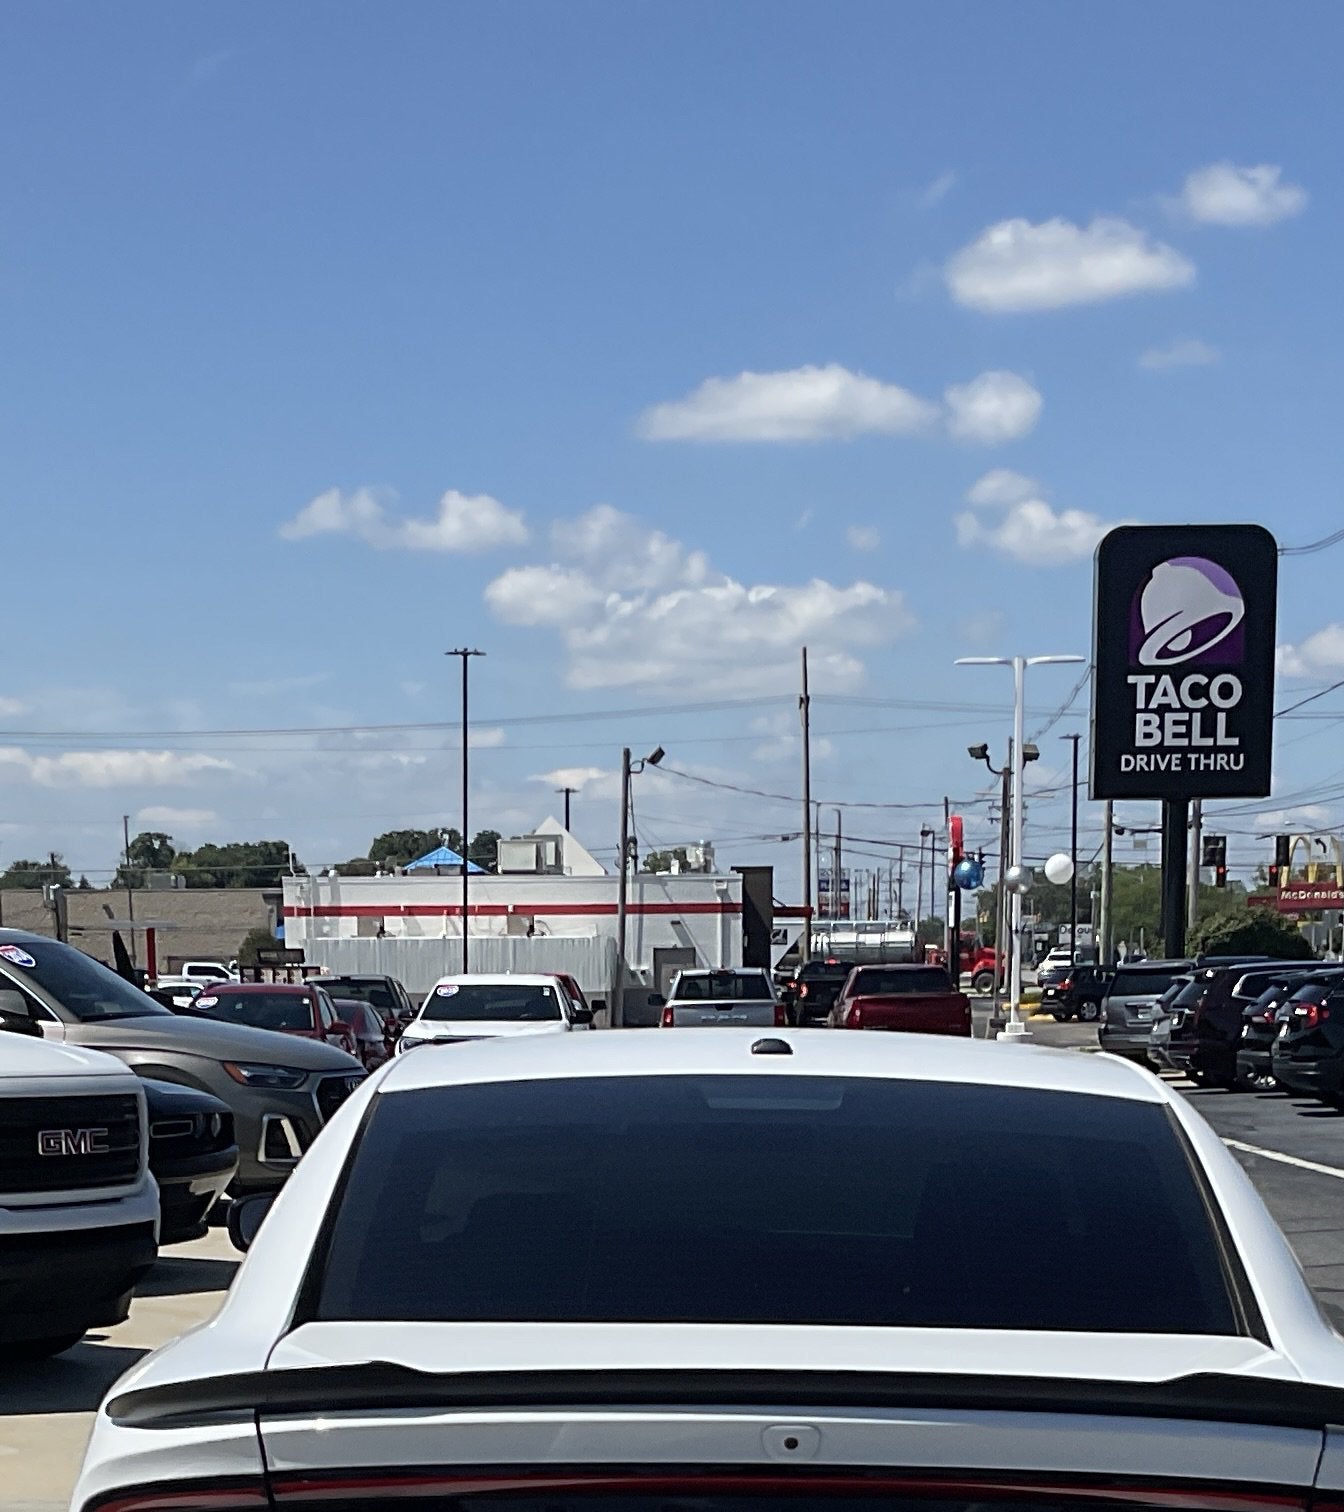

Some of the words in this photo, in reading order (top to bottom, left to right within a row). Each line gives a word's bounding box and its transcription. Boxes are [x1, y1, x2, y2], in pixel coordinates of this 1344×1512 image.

[1127, 673, 1243, 709] TACO
[1134, 712, 1240, 747] BELL
[1120, 753, 1182, 772] DRIVE
[1187, 753, 1244, 771] THRU
[38, 1128, 109, 1156] GMC
